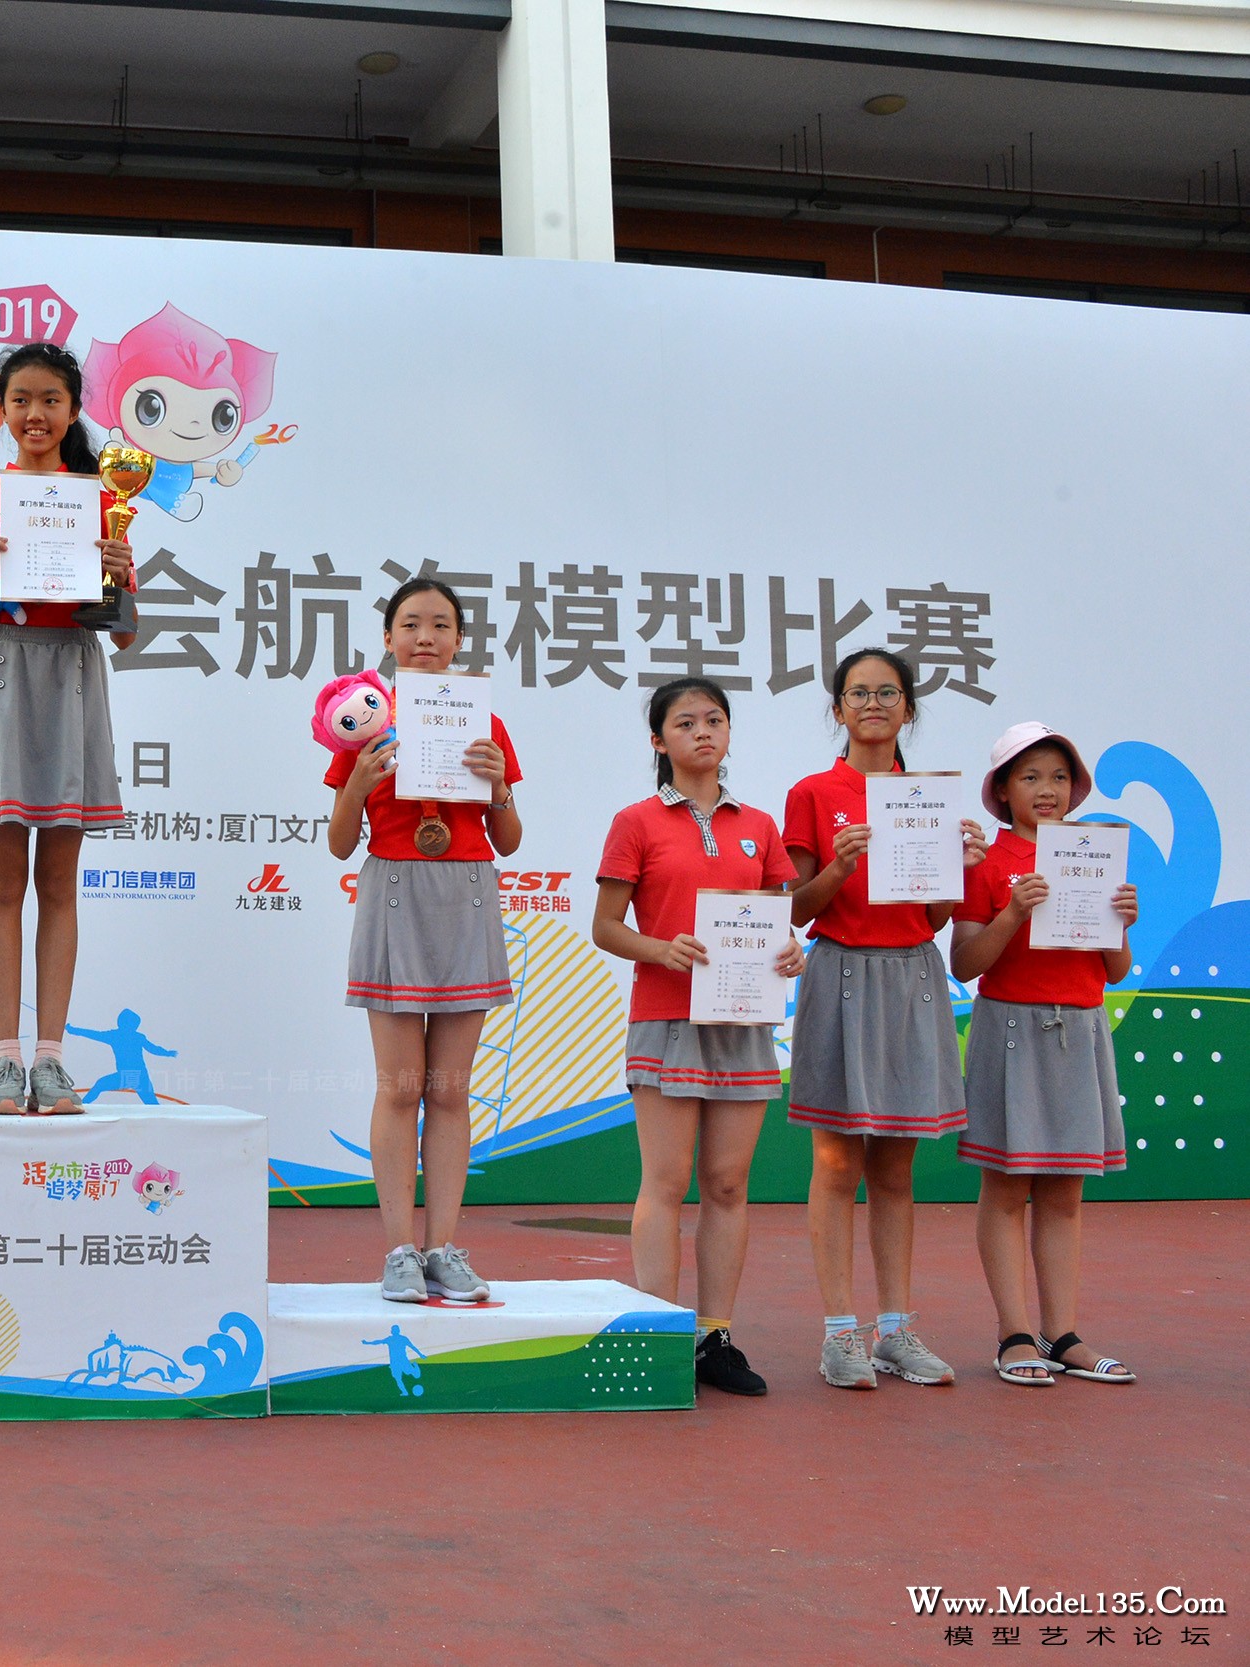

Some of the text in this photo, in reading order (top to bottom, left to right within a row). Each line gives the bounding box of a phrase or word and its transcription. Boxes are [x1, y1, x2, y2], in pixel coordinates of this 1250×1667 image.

[18, 500, 83, 511] 厦门市第二十届运动会
[27, 515, 77, 529] 获奖证书
[414, 698, 474, 709] 厦门市第二十届运动会
[421, 713, 468, 728] 获奖证书
[885, 802, 946, 810] 厦门市第二十届运动会
[894, 817, 939, 830] 获奖证书
[1053, 850, 1111, 861] 厦门市第二十届运动会
[1060, 864, 1105, 878] 获奖证书
[82, 869, 196, 890] 厦门信息集团
[498, 871, 572, 891] CST
[112, 892, 166, 900] INFORMATION
[168, 893, 196, 901] GROUP
[236, 895, 302, 911] 九龙建设
[713, 921, 774, 930] 厦门市第二十届运动会
[720, 936, 766, 949] 获奖证书
[105, 1161, 129, 1173] 2019
[22, 1161, 102, 1187] 活力市运
[46, 1178, 121, 1201] 追梦厦门
